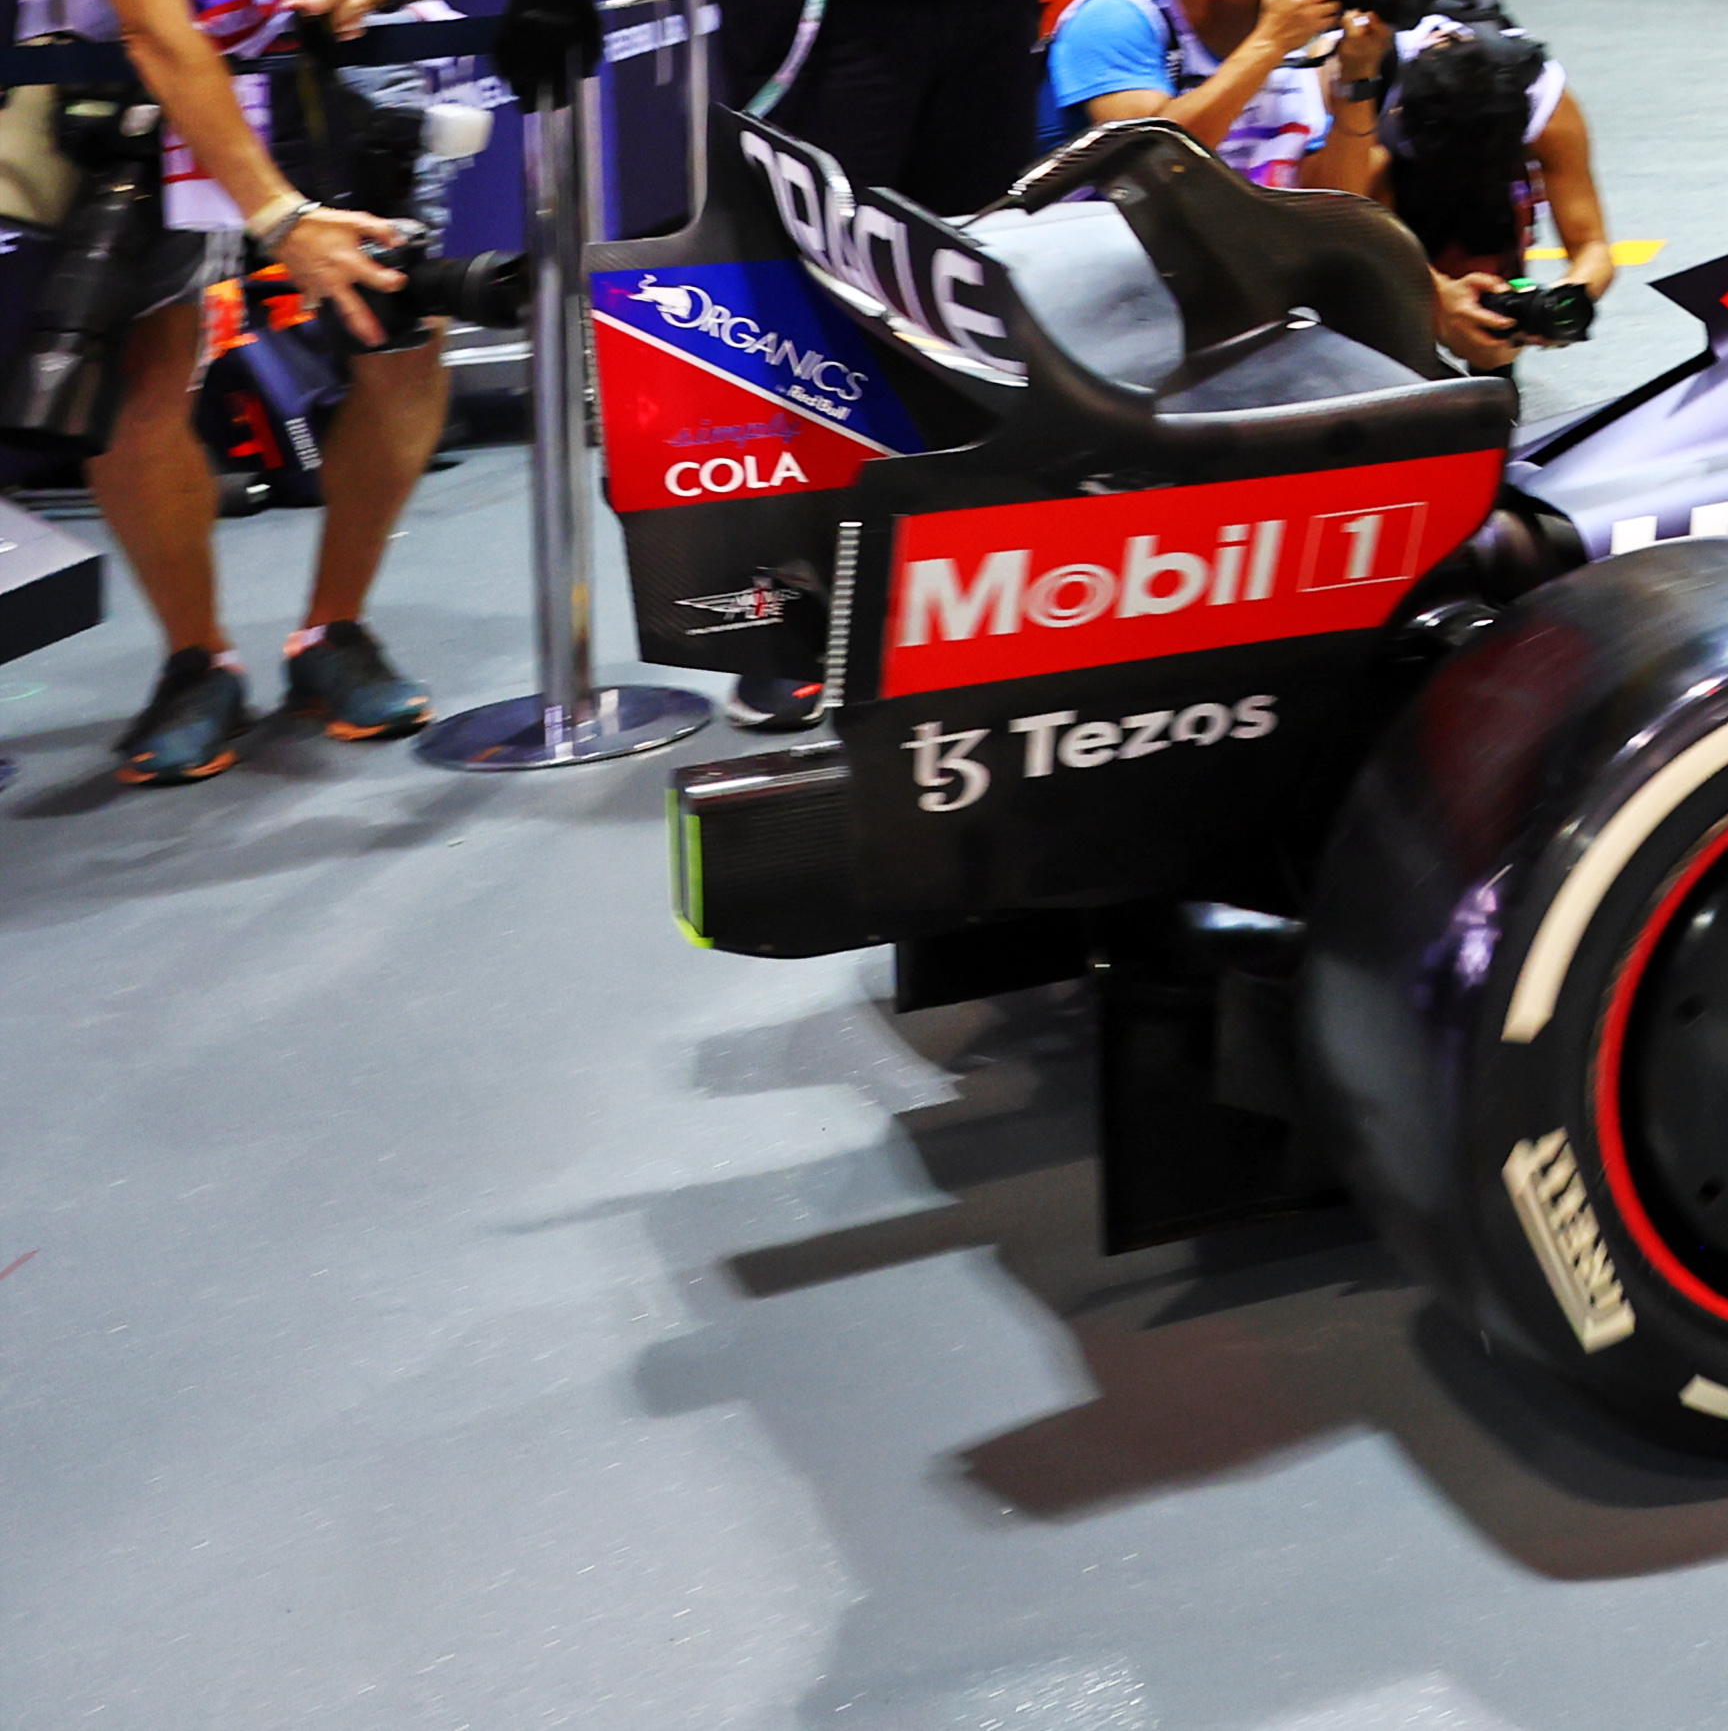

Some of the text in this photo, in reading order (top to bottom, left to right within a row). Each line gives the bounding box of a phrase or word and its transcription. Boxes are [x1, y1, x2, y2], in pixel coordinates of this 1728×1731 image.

[739, 129, 1029, 377] ORACLE
[655, 284, 868, 401] ORGANICS
[664, 451, 810, 497] COLA
[897, 520, 1286, 649] Mobil
[1344, 514, 1381, 581] 1
[1010, 693, 1279, 779] Tezos
